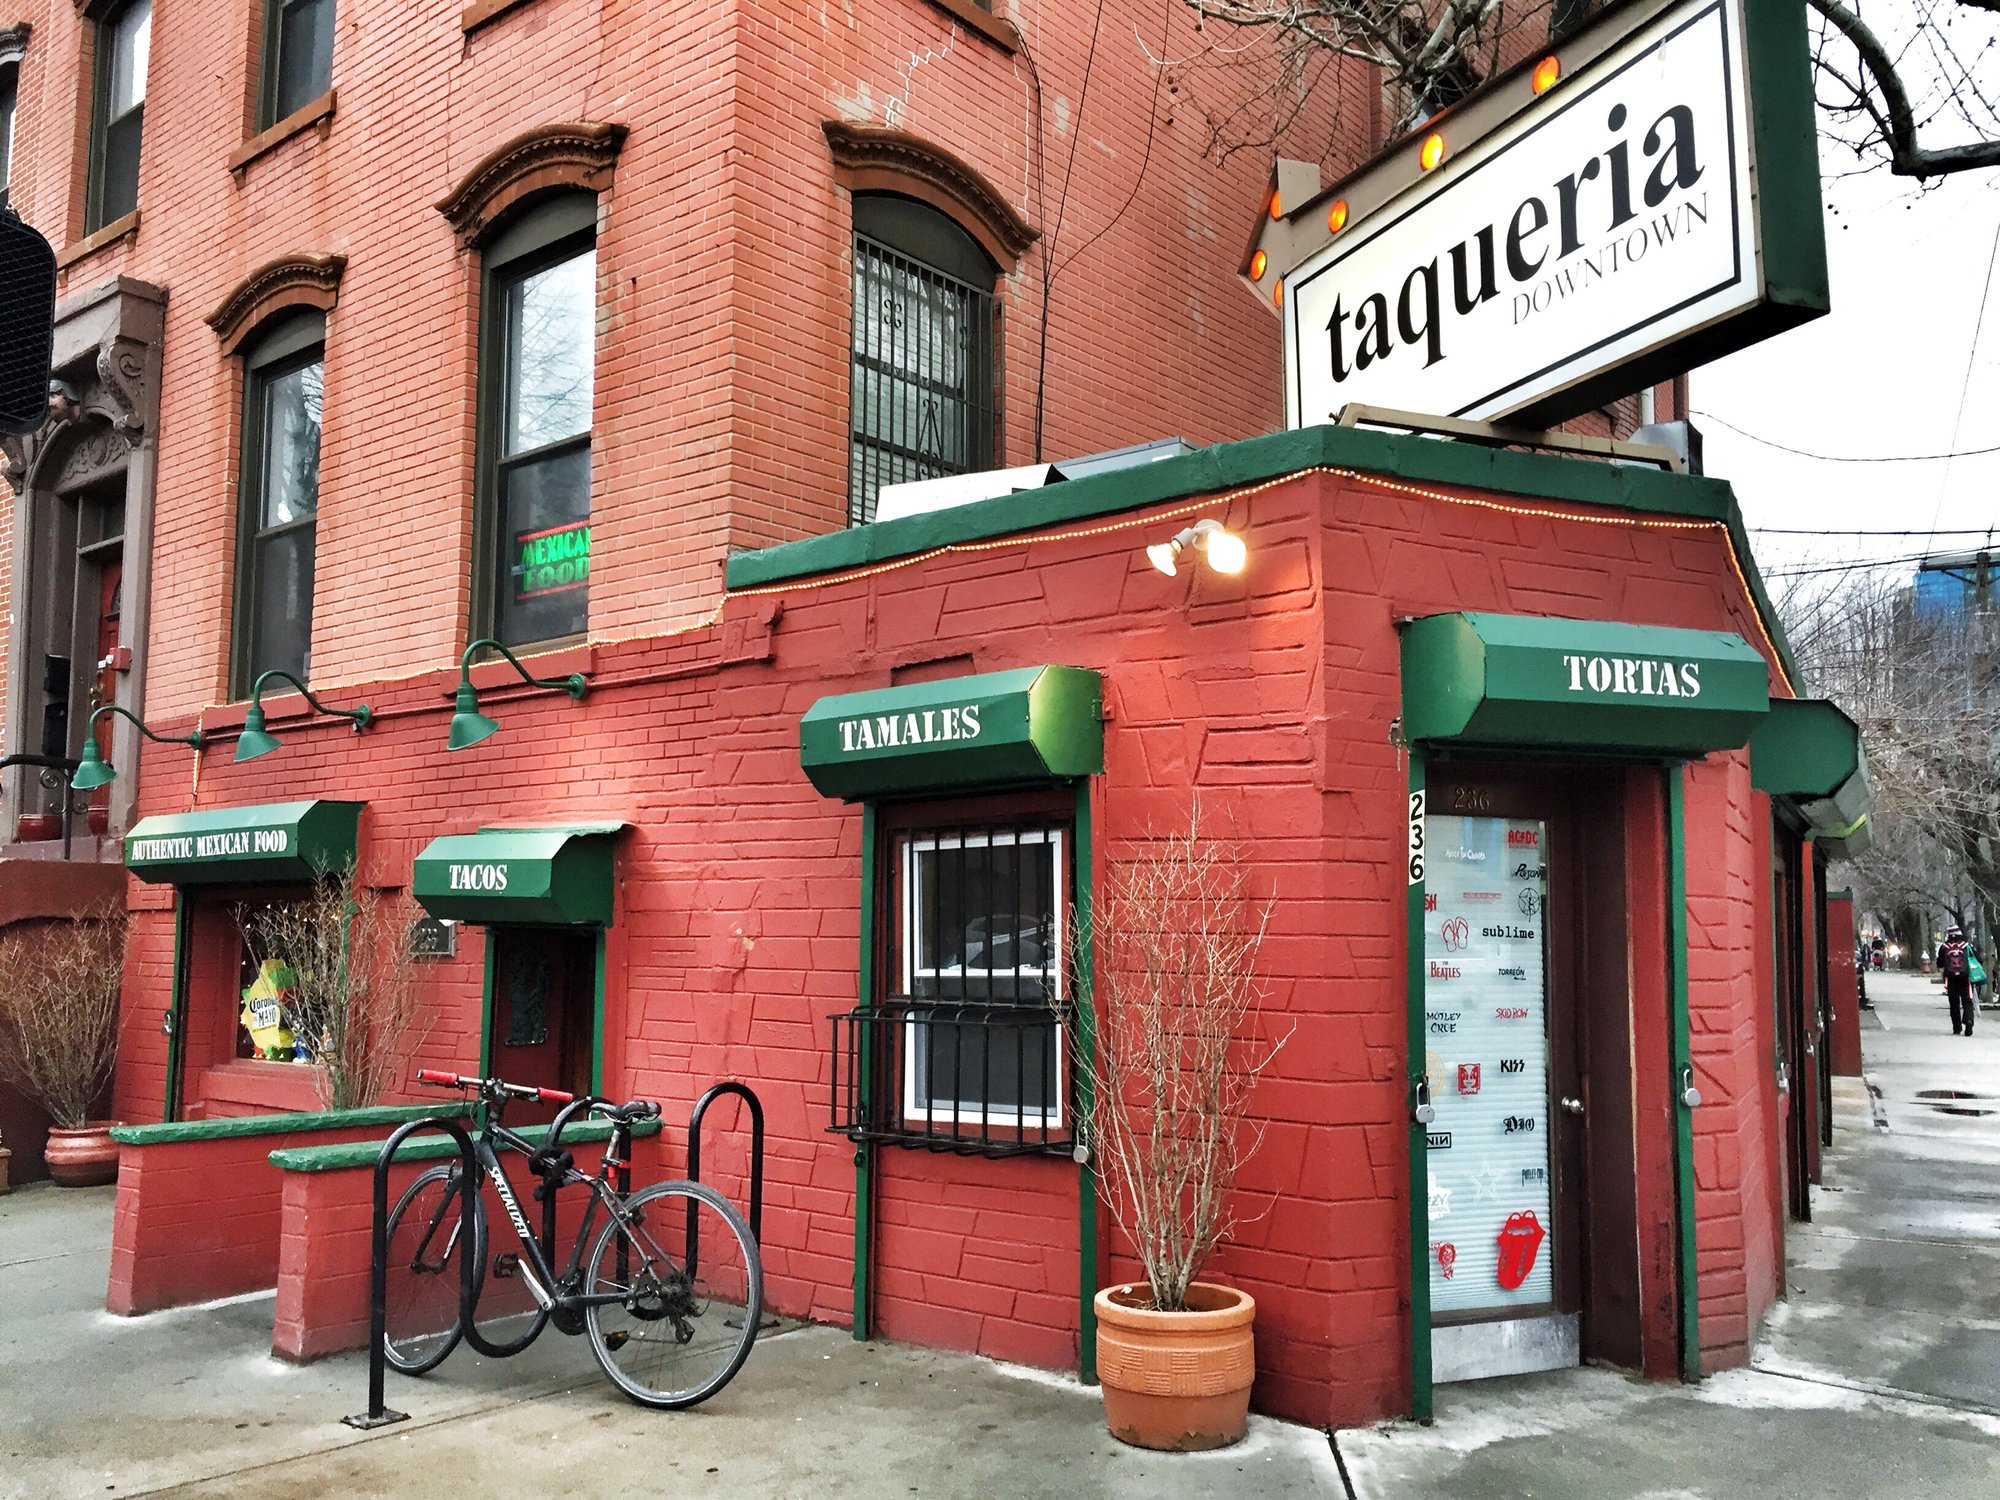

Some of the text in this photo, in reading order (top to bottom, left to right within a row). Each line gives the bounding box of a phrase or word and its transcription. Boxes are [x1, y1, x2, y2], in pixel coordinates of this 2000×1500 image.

[1325, 103, 1706, 383] taqueria
[1513, 192, 1708, 326] DOWNTOWN
[523, 557, 590, 592] FOOD
[1563, 655, 1701, 698] TORTAS
[839, 704, 981, 751] TAMALES
[1455, 787, 1490, 810] 236
[132, 830, 288, 861] AUTHENTIC MEXICAN FOOD
[449, 864, 508, 890] TACOS
[1482, 925, 1535, 939] sublime
[1501, 1059, 1525, 1072] KISS
[487, 1166, 530, 1238] SPECIALIZED
